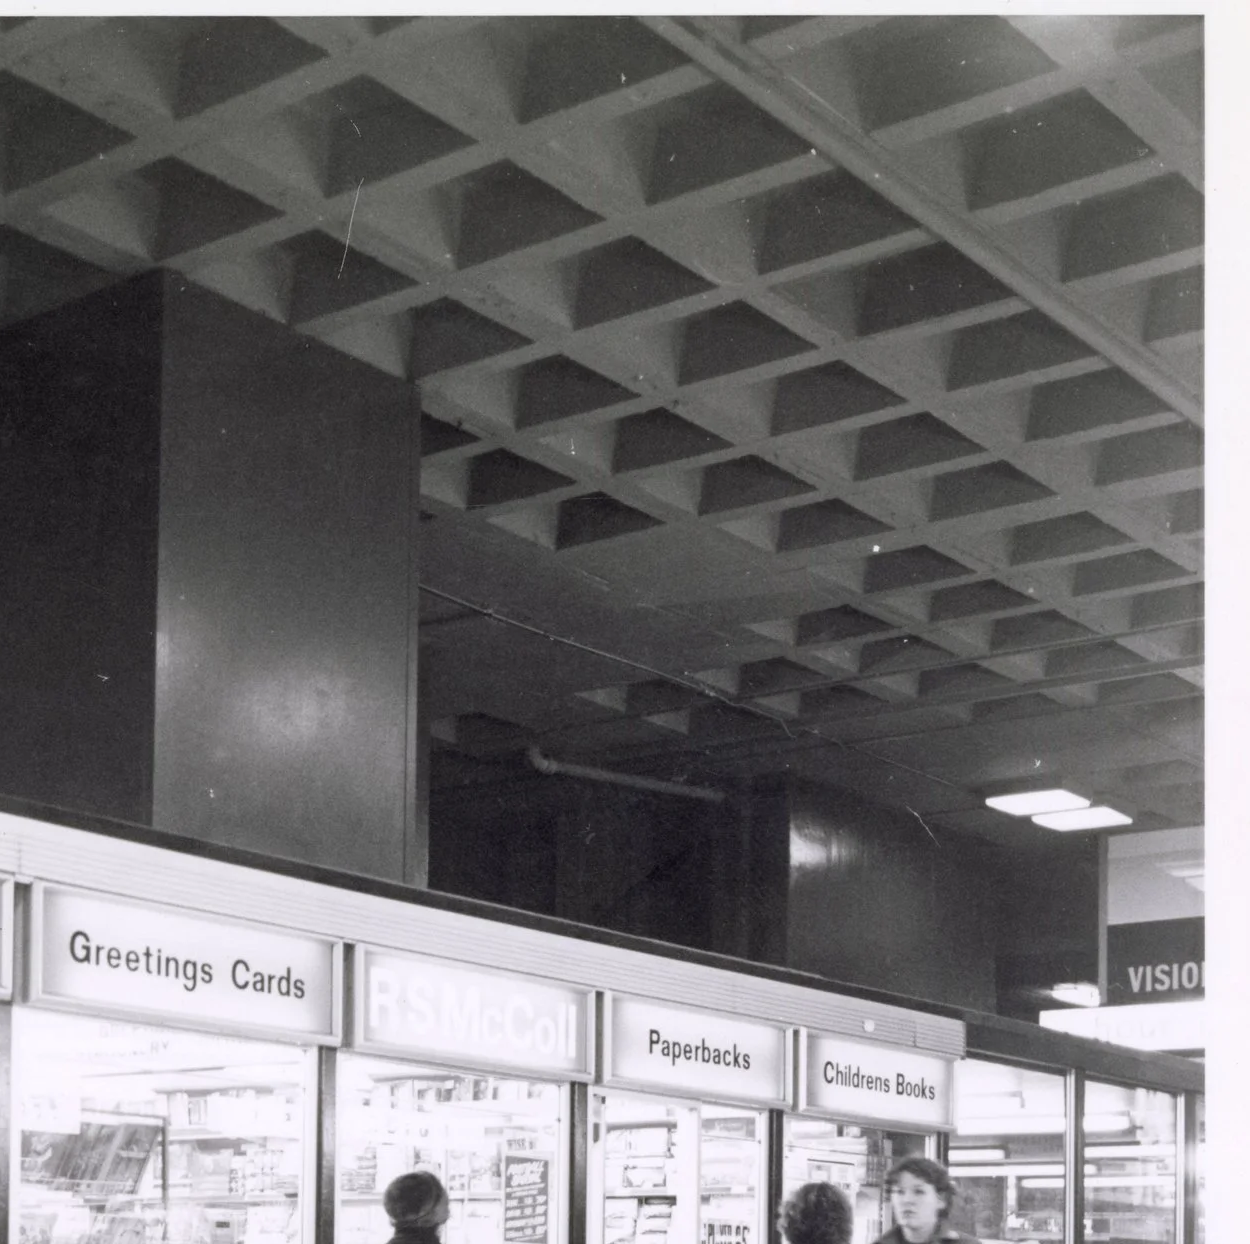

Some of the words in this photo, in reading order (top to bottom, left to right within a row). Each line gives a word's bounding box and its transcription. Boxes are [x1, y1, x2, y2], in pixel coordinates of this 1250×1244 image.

[69, 931, 214, 992] Greetings
[231, 959, 307, 999] Cards
[648, 1029, 752, 1071] Paperbacks
[823, 1061, 891, 1094] Childrens
[896, 1074, 936, 1100] Books
